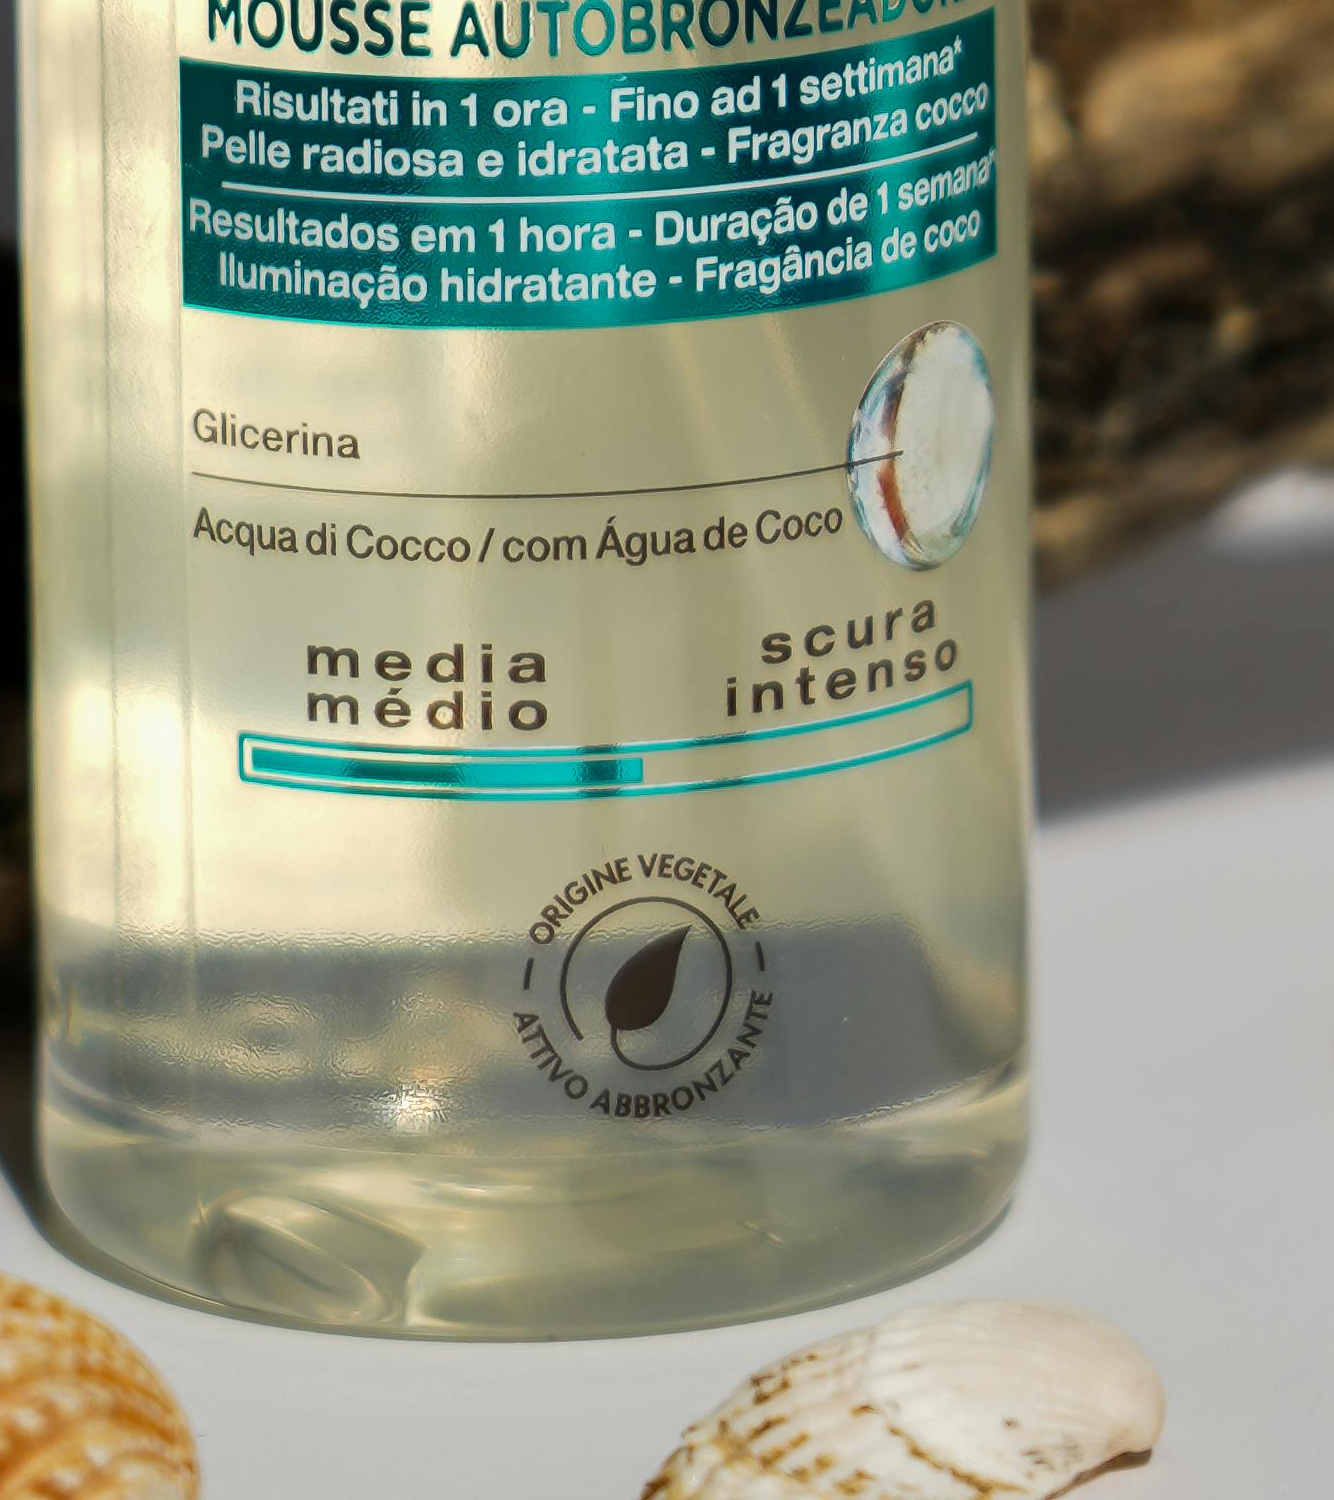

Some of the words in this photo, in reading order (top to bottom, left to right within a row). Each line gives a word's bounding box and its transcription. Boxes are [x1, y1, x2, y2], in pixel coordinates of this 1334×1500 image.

[201, 124, 291, 170] Pelle
[302, 139, 464, 178] radiosa
[476, 148, 504, 178] e
[517, 138, 689, 178] idratata
[728, 107, 908, 165] Fragranza
[914, 81, 989, 131] cocco
[235, 79, 398, 127] Risultati
[411, 91, 447, 127] in
[460, 93, 478, 128] 1
[493, 97, 568, 127] ora
[610, 86, 700, 123] Fino
[711, 76, 760, 117] ad
[771, 73, 787, 108] 1
[189, 198, 400, 253] Resultados
[411, 223, 476, 253] em
[488, 218, 505, 254] 1
[520, 217, 616, 253] hora
[655, 196, 818, 247] Duração
[827, 187, 868, 224] de
[876, 181, 889, 215] 1
[219, 251, 427, 310] Iluminação
[441, 264, 657, 304] hidratante
[695, 236, 873, 295] Fragância
[881, 227, 916, 264] de
[923, 209, 980, 254] coco
[193, 408, 361, 460] Glicerina
[193, 506, 298, 556] Acqua
[305, 522, 337, 556] di
[346, 524, 471, 563] Cocco
[503, 534, 587, 563] com
[596, 516, 696, 566] Água
[703, 517, 748, 550] de
[756, 507, 843, 544] Coco
[305, 642, 548, 685] media
[760, 598, 936, 666] scura
[305, 687, 549, 732] médio
[725, 638, 958, 718] intenso
[529, 857, 632, 945] ORIGINE
[637, 853, 760, 931] VEGETALE
[513, 1011, 589, 1100] ATTIVO
[589, 990, 773, 1119] ABBRONZANTE
